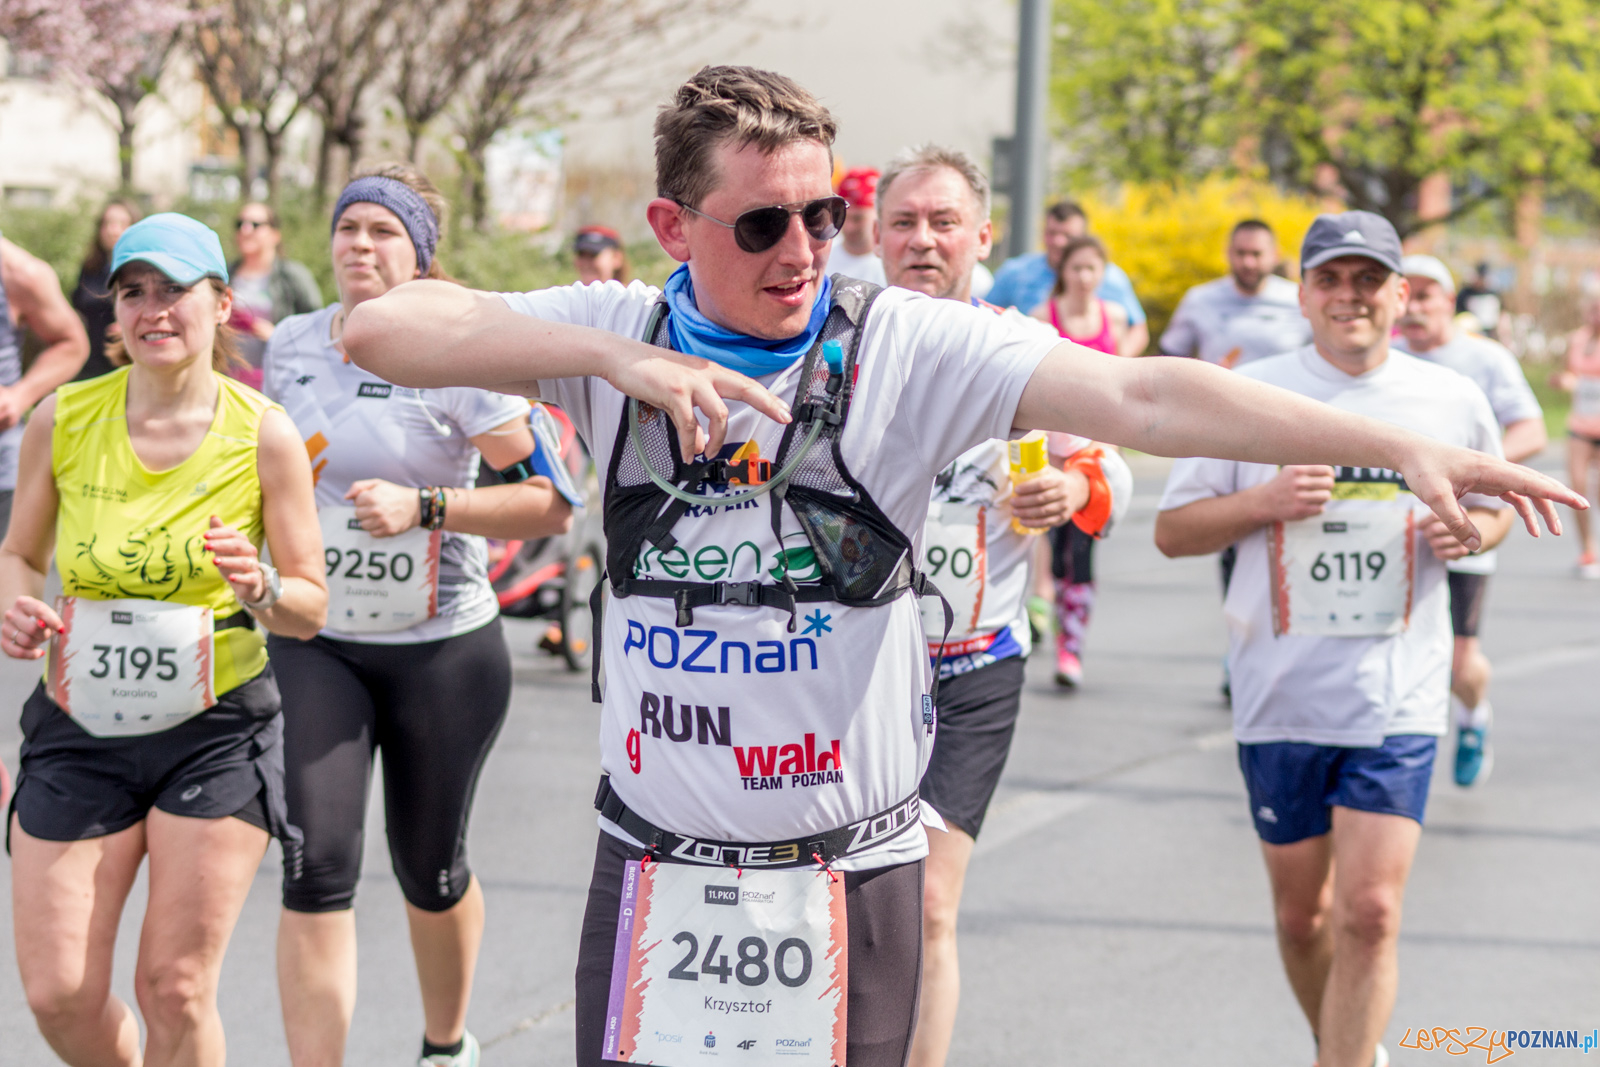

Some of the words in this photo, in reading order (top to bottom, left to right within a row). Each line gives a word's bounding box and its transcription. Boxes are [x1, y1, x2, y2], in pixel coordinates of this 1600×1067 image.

[325, 547, 414, 582] 9250
[1310, 551, 1386, 582] 6119
[89, 645, 179, 682] 3195
[112, 687, 158, 699] Karolina
[741, 776, 783, 791] TEAM
[670, 833, 800, 865] ZONE3
[625, 866, 636, 900] 15.04.2018
[708, 889, 737, 901] 11.PKO
[623, 907, 633, 917] D
[668, 930, 813, 988] 2480
[704, 996, 773, 1015] Krzysztof
[736, 1039, 757, 1050] 4F
